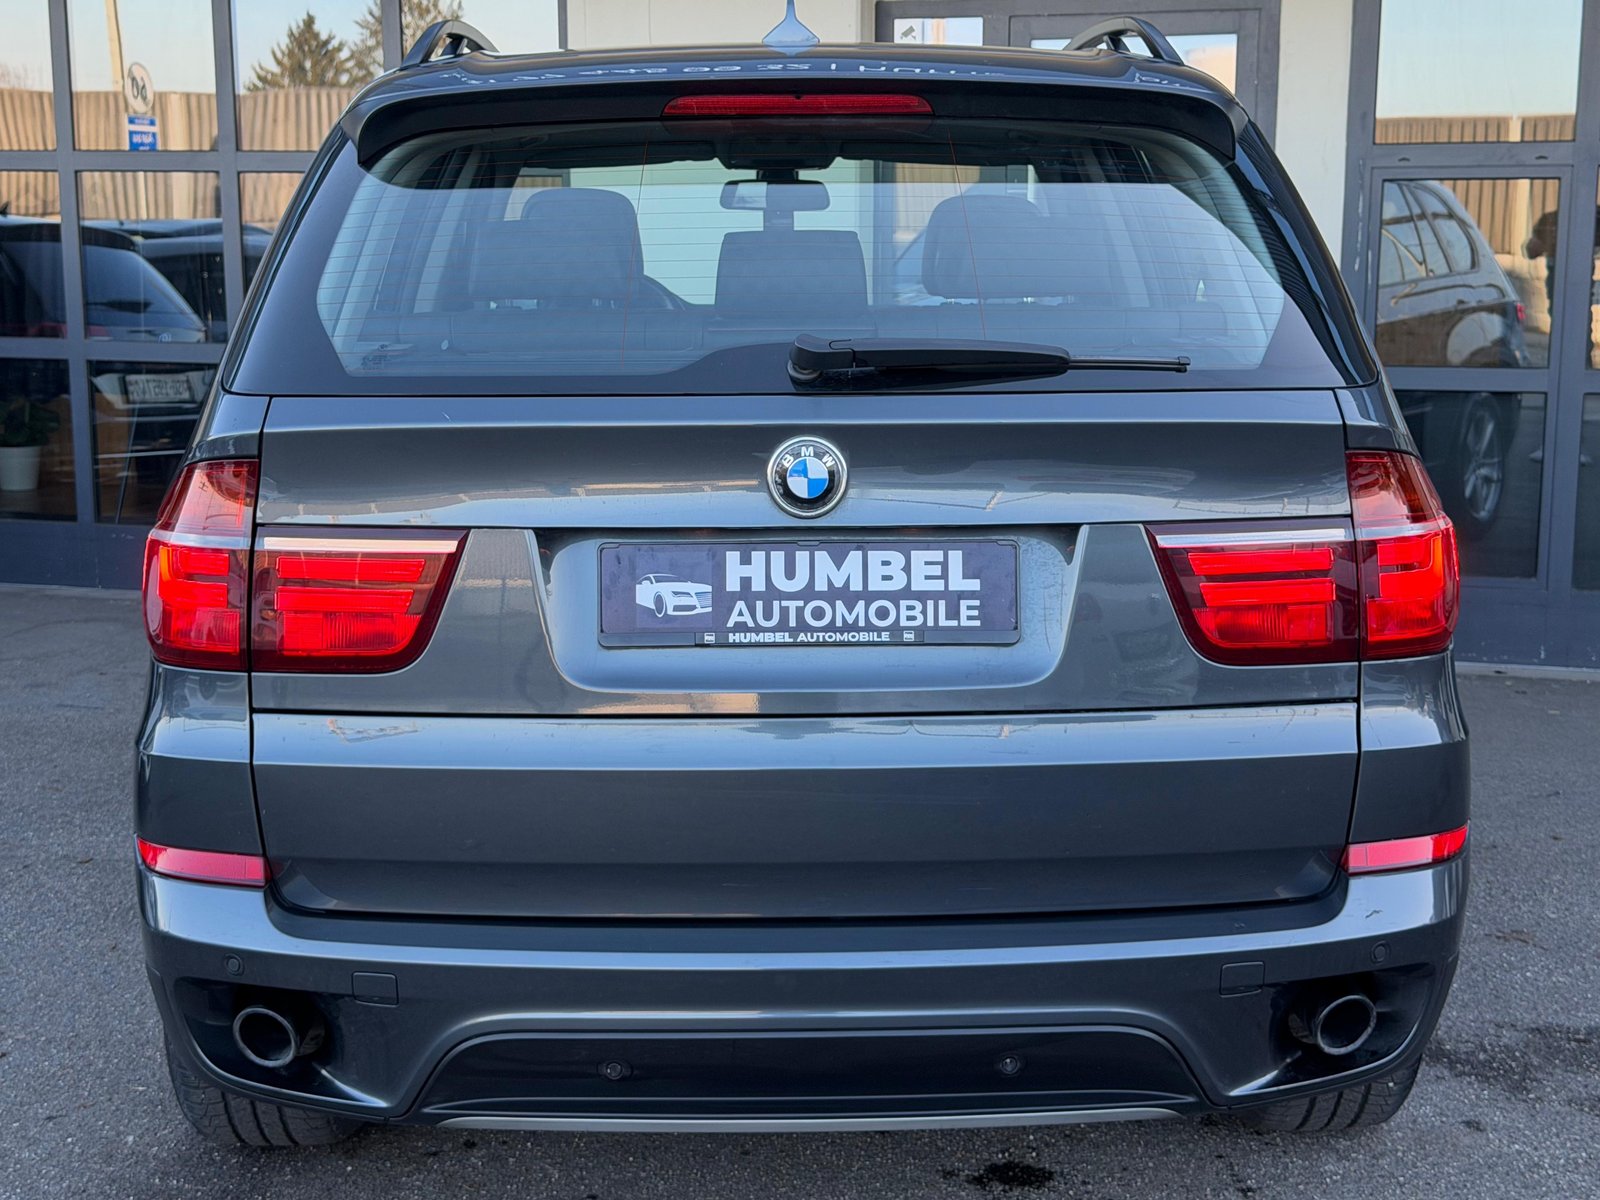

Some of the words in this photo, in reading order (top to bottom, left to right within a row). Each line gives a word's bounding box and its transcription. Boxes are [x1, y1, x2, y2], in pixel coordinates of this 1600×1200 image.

[781, 446, 836, 468] BMW
[725, 549, 981, 592] HUMBEL
[726, 598, 981, 628] AUTOMOBILE
[728, 631, 794, 643] HUMBEL
[796, 631, 890, 643] AUTOMOBILE
